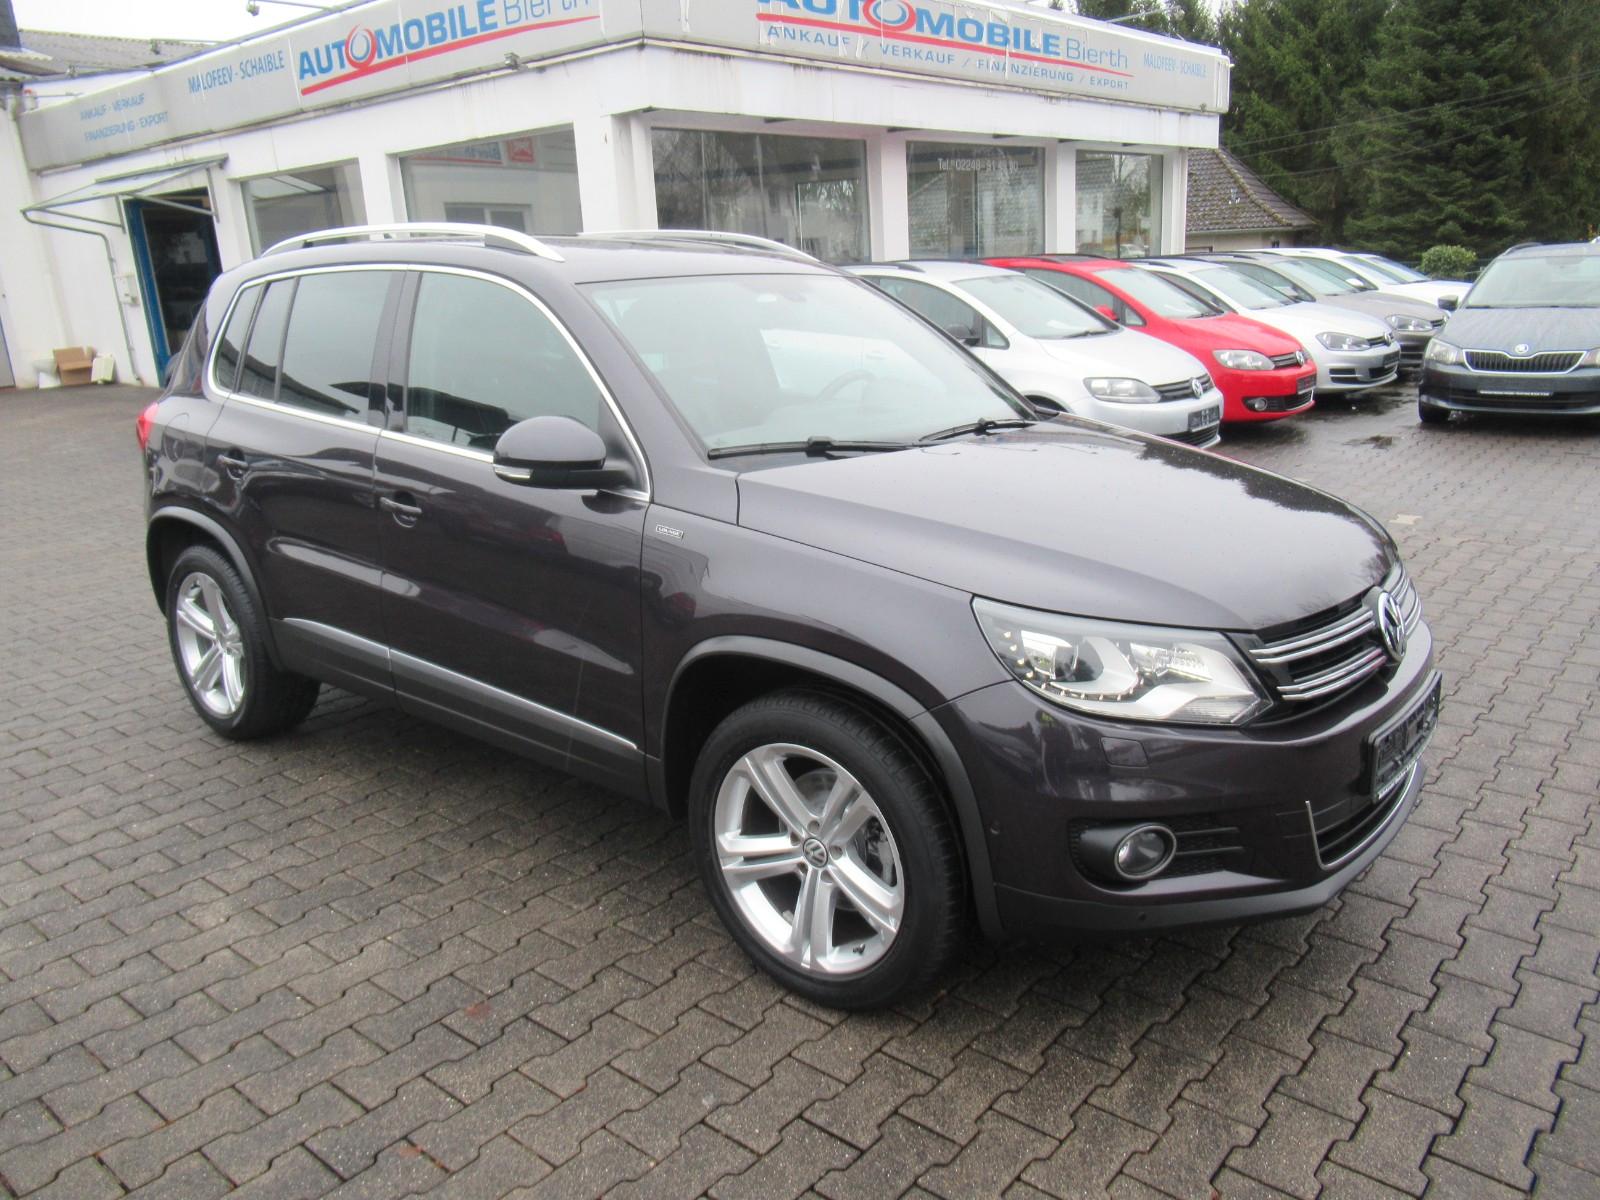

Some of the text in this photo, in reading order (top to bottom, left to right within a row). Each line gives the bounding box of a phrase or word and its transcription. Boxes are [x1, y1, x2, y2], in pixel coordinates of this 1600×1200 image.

[299, 0, 590, 79] AUTOMOBILE Bier
[767, 25, 850, 47] ANKAUF
[880, 43, 955, 65] VERKAUF
[1090, 75, 1129, 89] EXPORT
[1066, 38, 1128, 69] Bierth
[188, 65, 233, 94] MALOFEEV
[239, 50, 285, 81] SCHAIBLE
[139, 111, 168, 129] EXPORT
